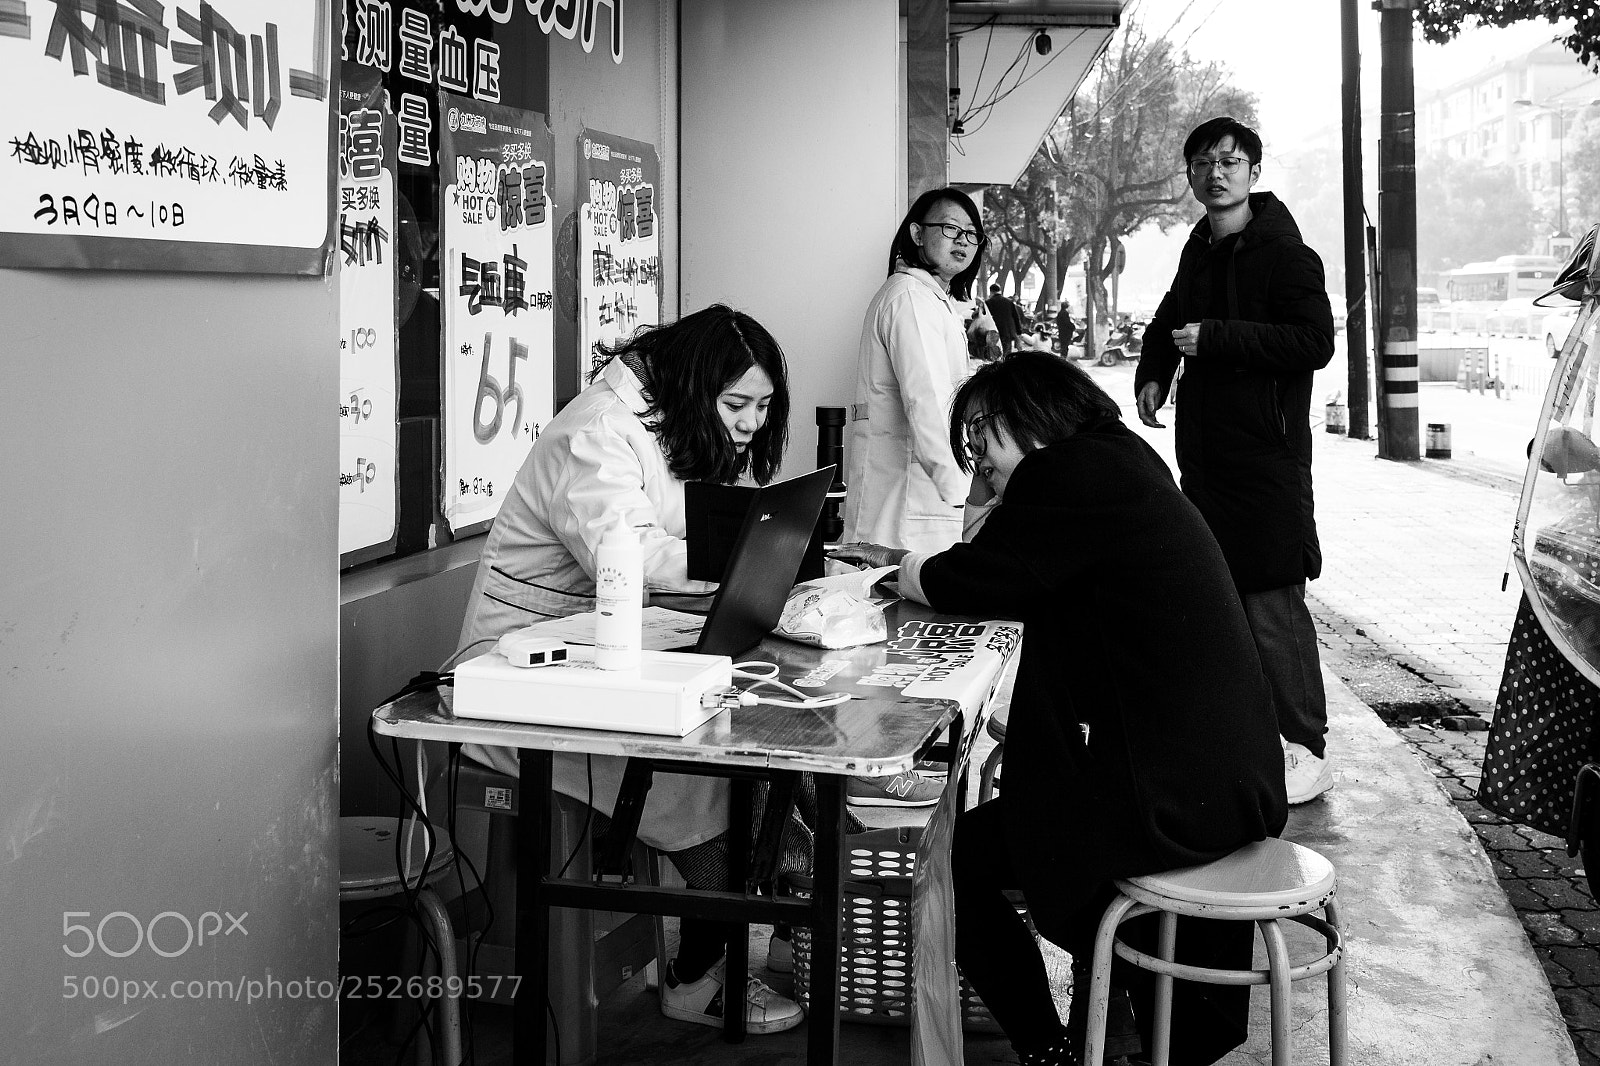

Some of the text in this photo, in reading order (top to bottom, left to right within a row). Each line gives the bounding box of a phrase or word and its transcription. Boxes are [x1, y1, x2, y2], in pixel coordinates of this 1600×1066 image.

[341, 0, 501, 103] 测量血压
[502, 142, 532, 162] 多买多换
[341, 185, 381, 211] 买多换
[456, 155, 496, 195] 购物
[498, 160, 547, 233] 惊喜
[462, 195, 484, 210] HOT
[462, 210, 483, 225] SALE
[594, 211, 608, 225] HOT
[616, 182, 654, 244] 惊喜
[594, 226, 608, 237] SALE
[473, 331, 529, 446] 65
[947, 654, 975, 667] SALE
[920, 666, 950, 682] HOT
[885, 775, 914, 798] N
